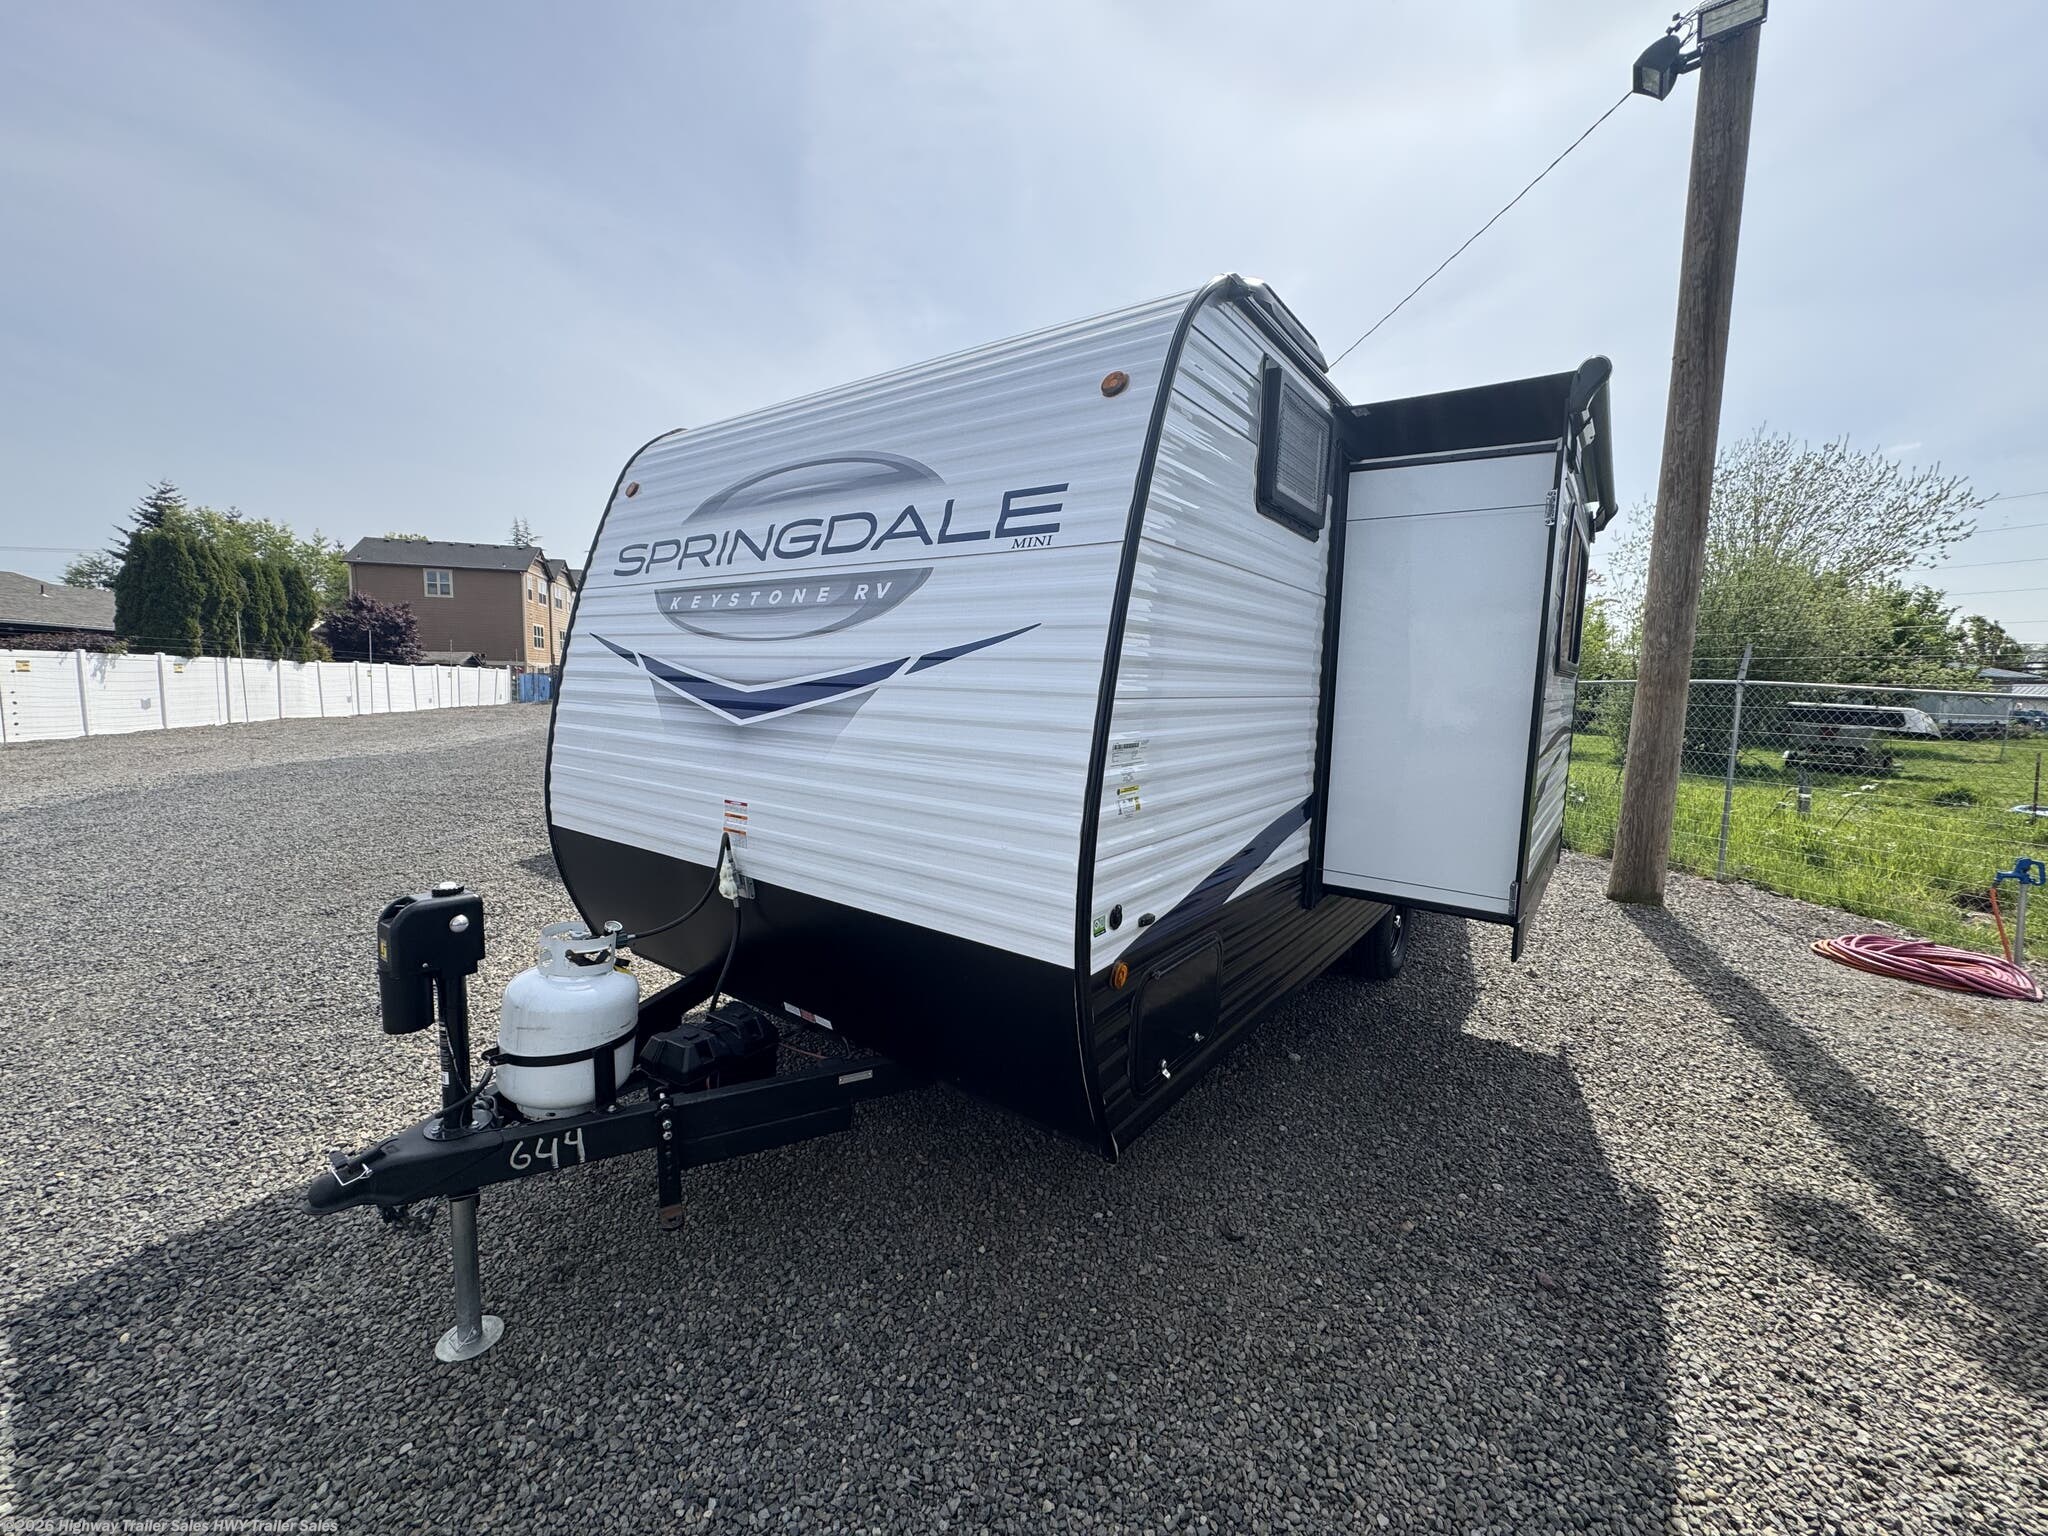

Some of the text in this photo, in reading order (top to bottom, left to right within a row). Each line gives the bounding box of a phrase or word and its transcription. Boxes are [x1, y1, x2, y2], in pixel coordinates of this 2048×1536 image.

[612, 482, 1070, 577] SPRINGDALE
[1010, 534, 1054, 551] MINI
[670, 581, 894, 611] KEYSTONE RV
[509, 1127, 586, 1170] 644
